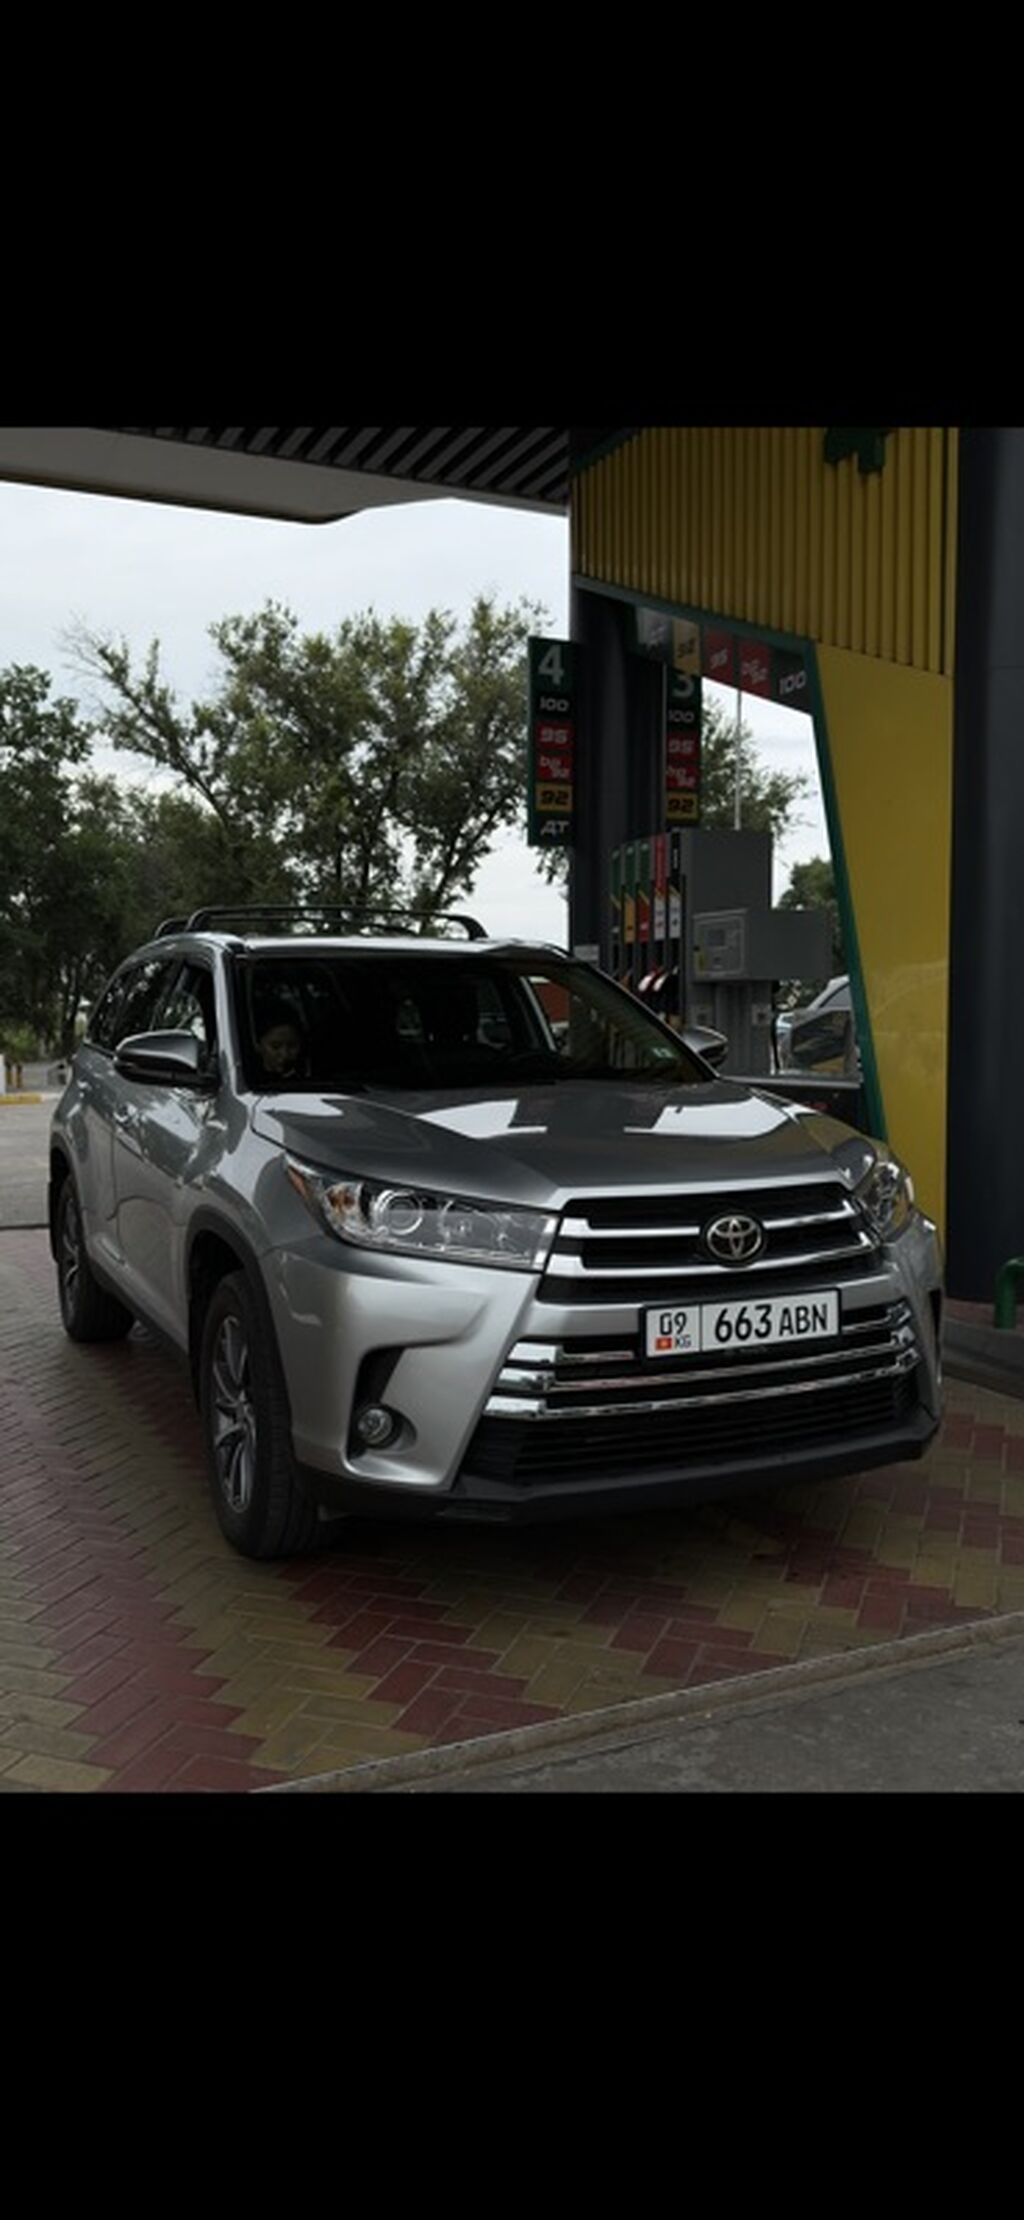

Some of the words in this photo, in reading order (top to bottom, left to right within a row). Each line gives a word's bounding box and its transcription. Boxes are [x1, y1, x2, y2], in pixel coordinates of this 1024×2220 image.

[538, 645, 564, 685] 4
[779, 671, 807, 695] 100
[540, 696, 569, 712] 100
[668, 710, 694, 723] 100
[540, 728, 569, 744] 95
[668, 739, 694, 754] 95
[541, 790, 569, 806] 92
[667, 799, 694, 813] 92
[660, 1312, 687, 1336] 09
[715, 1304, 772, 1343] 663
[779, 1303, 827, 1336] ABN
[675, 1335, 691, 1349] KG
